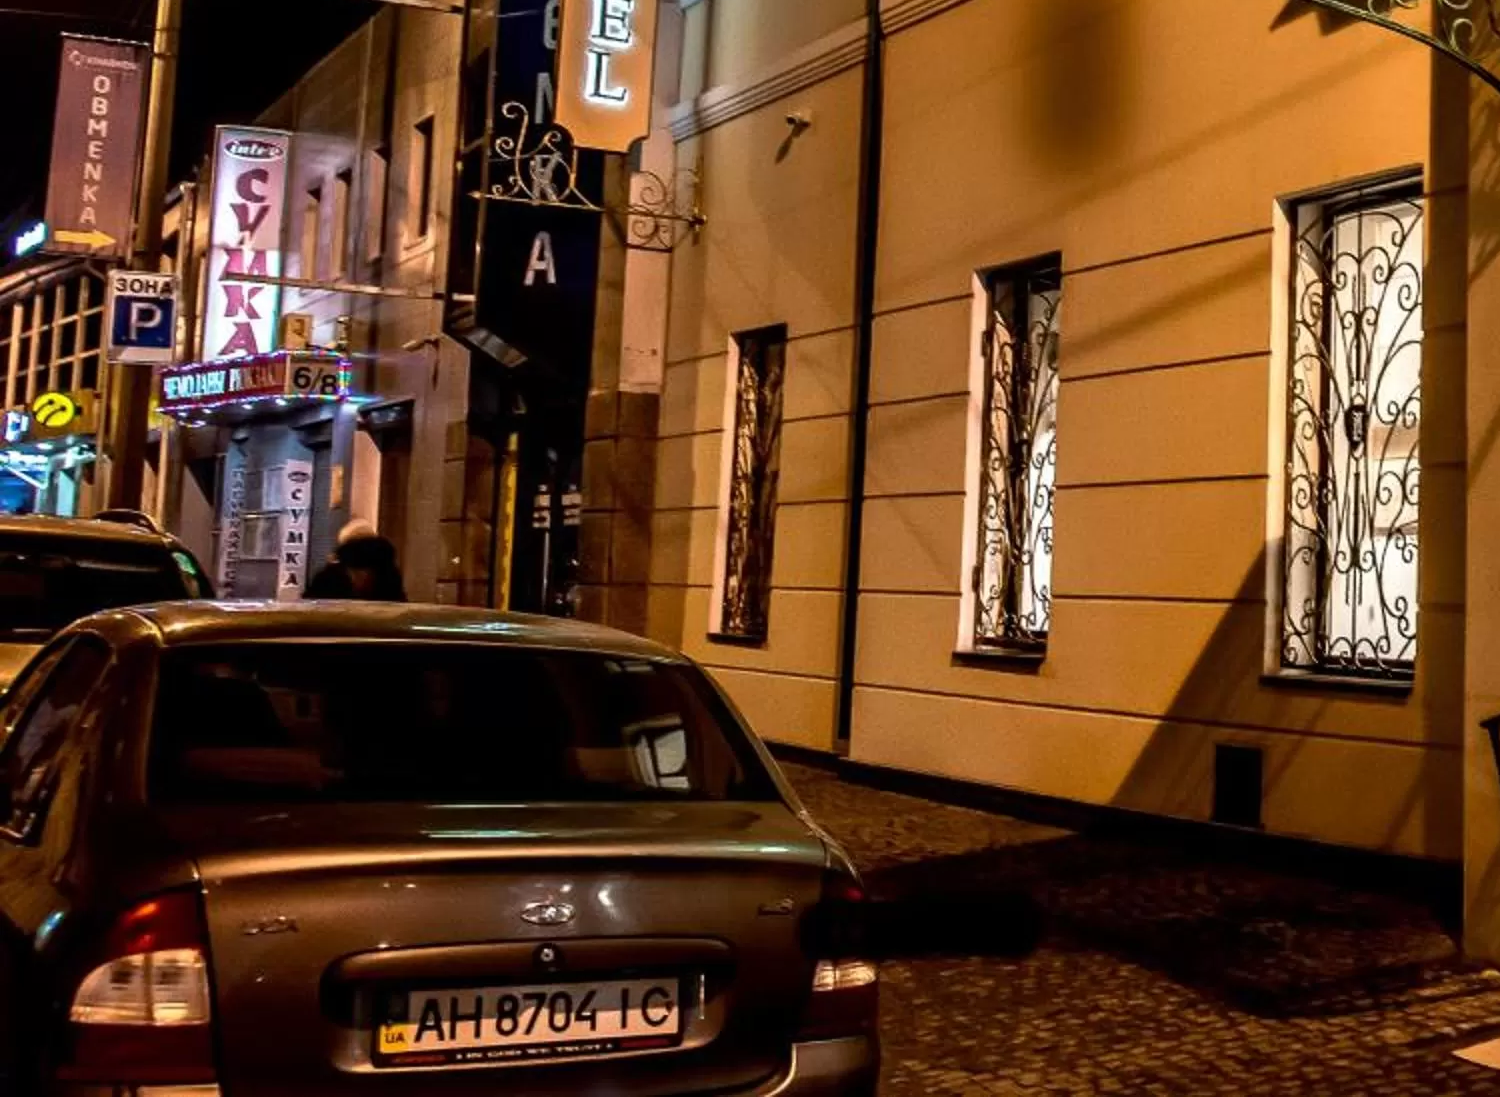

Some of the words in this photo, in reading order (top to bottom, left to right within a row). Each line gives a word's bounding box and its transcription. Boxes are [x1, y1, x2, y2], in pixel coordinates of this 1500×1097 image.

[80, 75, 111, 224] OBMENKA
[217, 168, 271, 356] СУМКА
[115, 278, 173, 295] ЗОНА
[129, 302, 162, 340] P
[293, 366, 337, 395] 6/8
[285, 488, 304, 586] СУМКА
[384, 1032, 405, 1044] UA
[414, 996, 483, 1043] AH
[495, 989, 597, 1037] 8704
[620, 986, 675, 1030] IC
